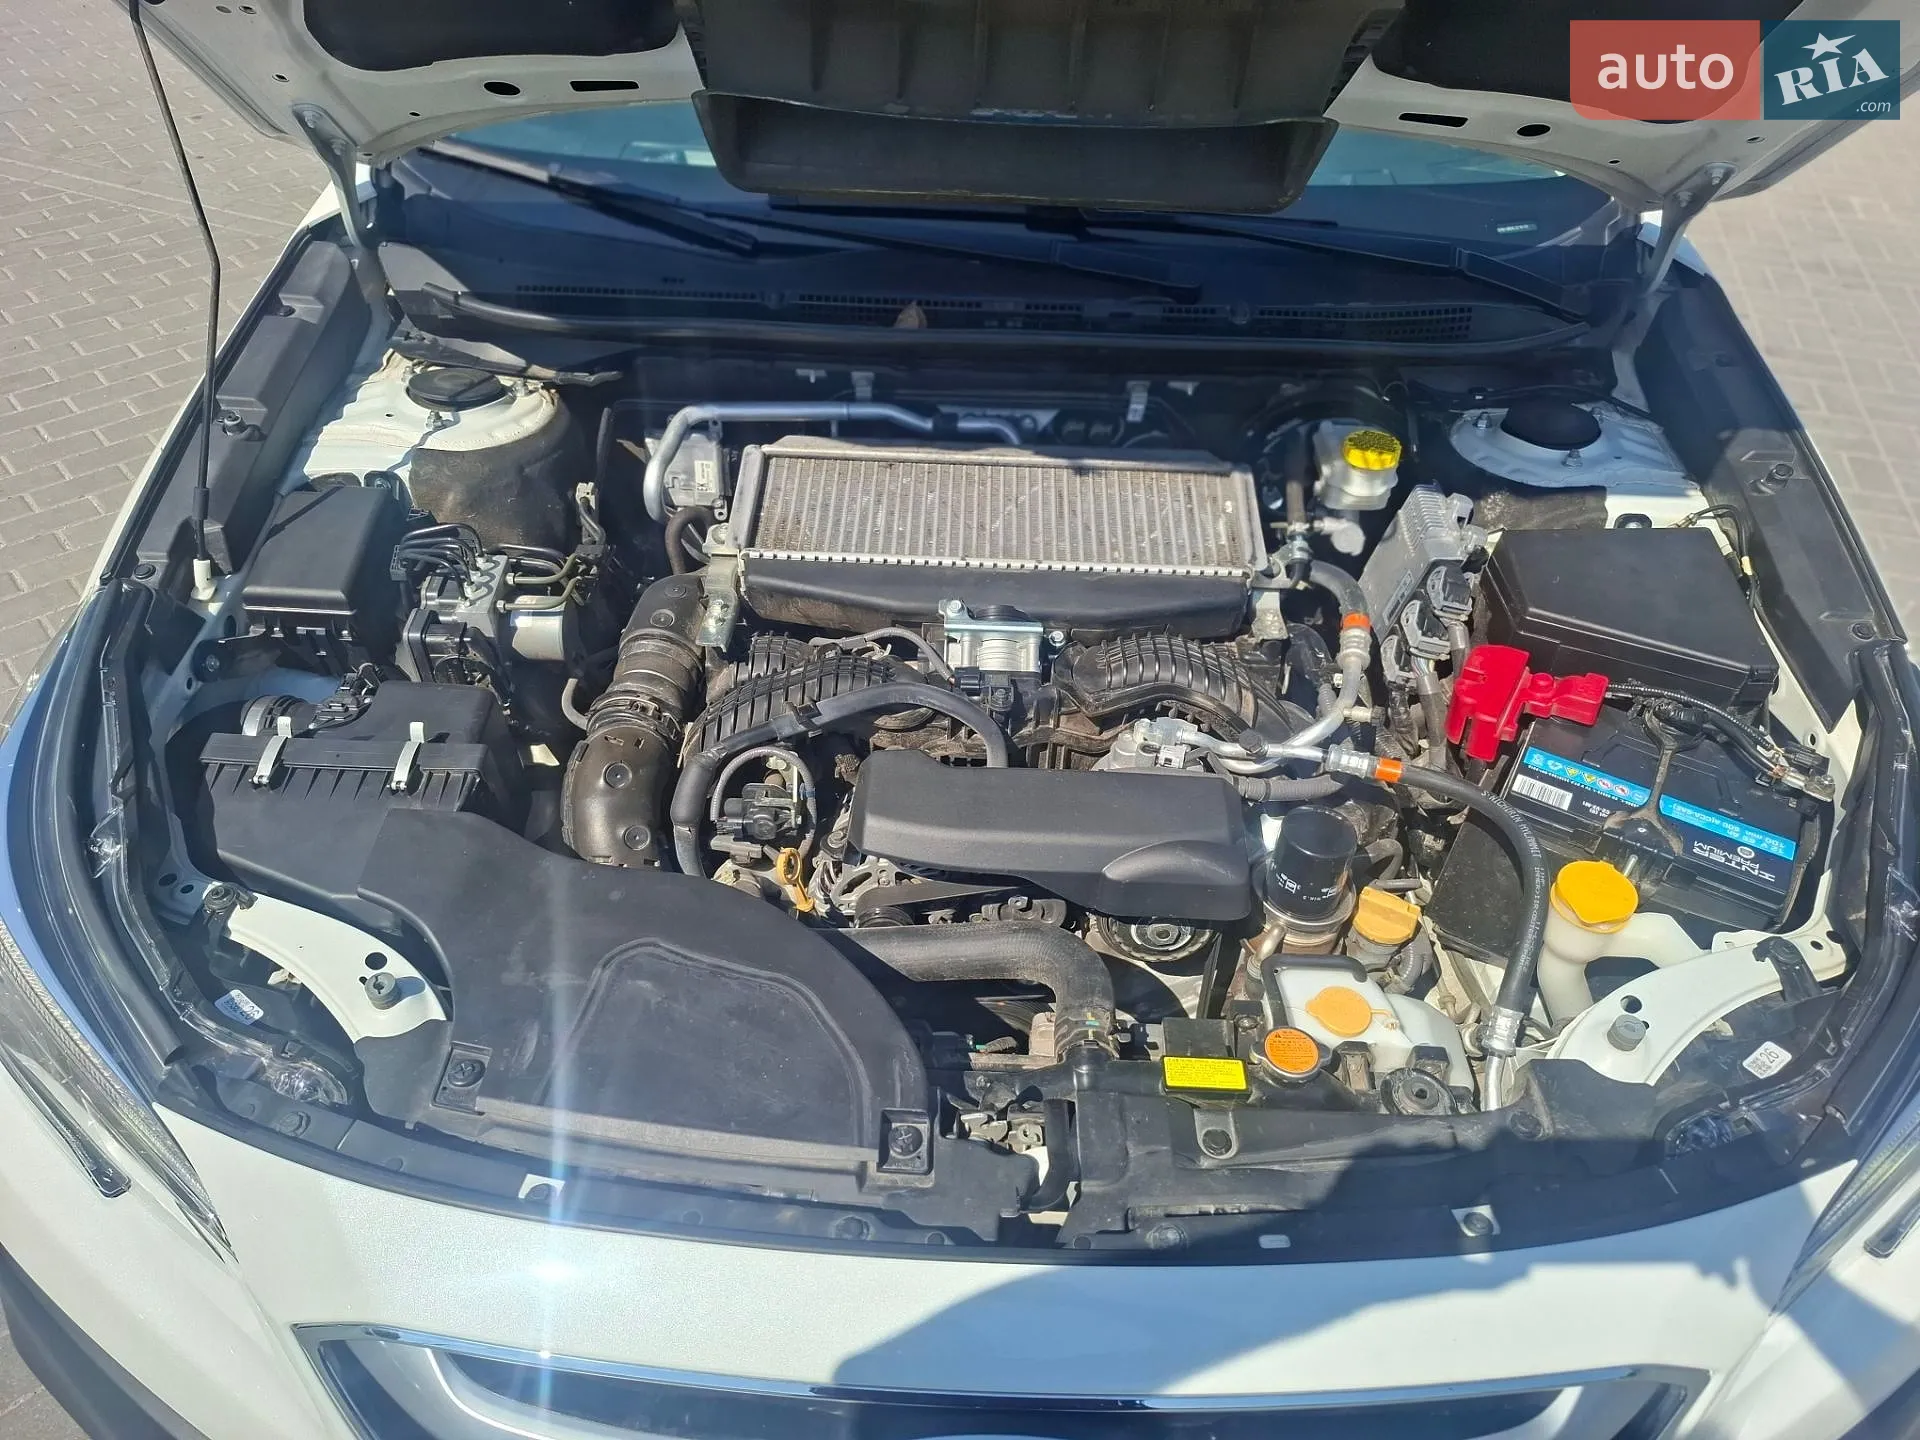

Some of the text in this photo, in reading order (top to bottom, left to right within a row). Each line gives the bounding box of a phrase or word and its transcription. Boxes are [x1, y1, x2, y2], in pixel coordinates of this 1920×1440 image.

[1692, 847, 1776, 882] INTER
[1694, 841, 1760, 870] PREMIUM
[1760, 1048, 1779, 1064] 26
